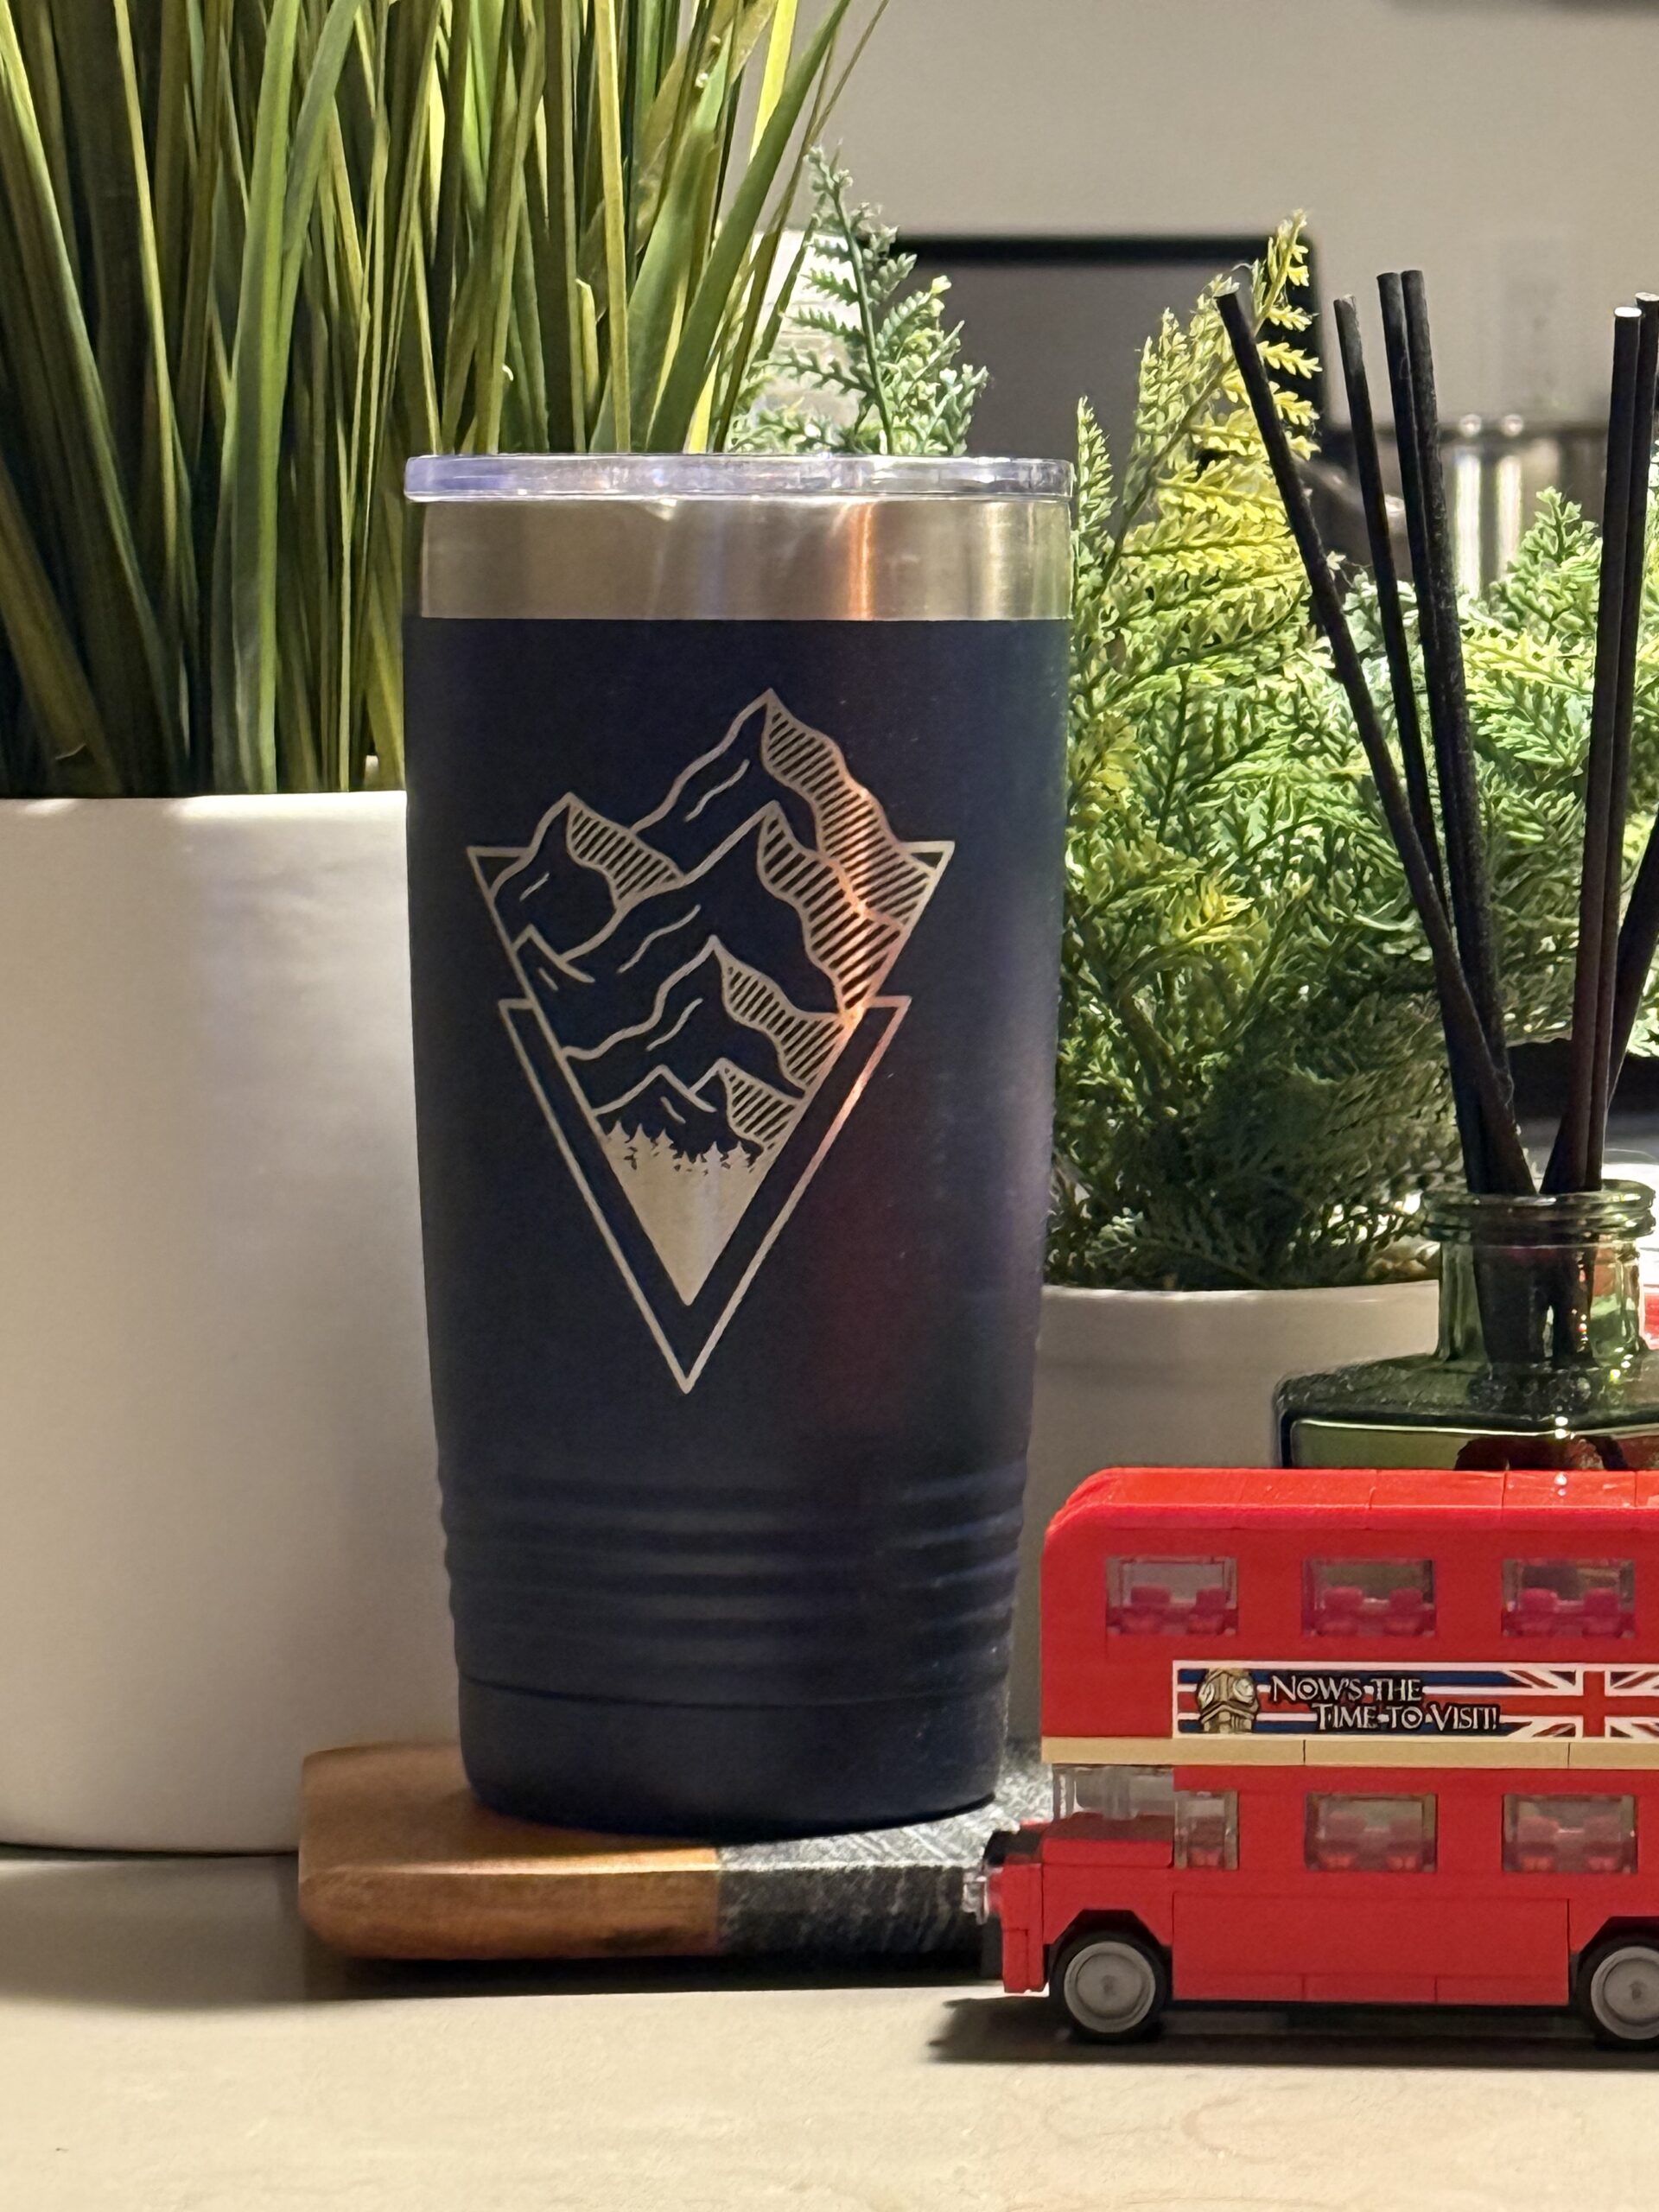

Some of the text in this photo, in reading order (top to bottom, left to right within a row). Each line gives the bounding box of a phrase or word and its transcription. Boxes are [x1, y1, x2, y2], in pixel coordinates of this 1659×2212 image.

[1272, 1675, 1422, 1701] NOW'S THE
[1312, 1703, 1497, 1731] TIME TO VISIT!
